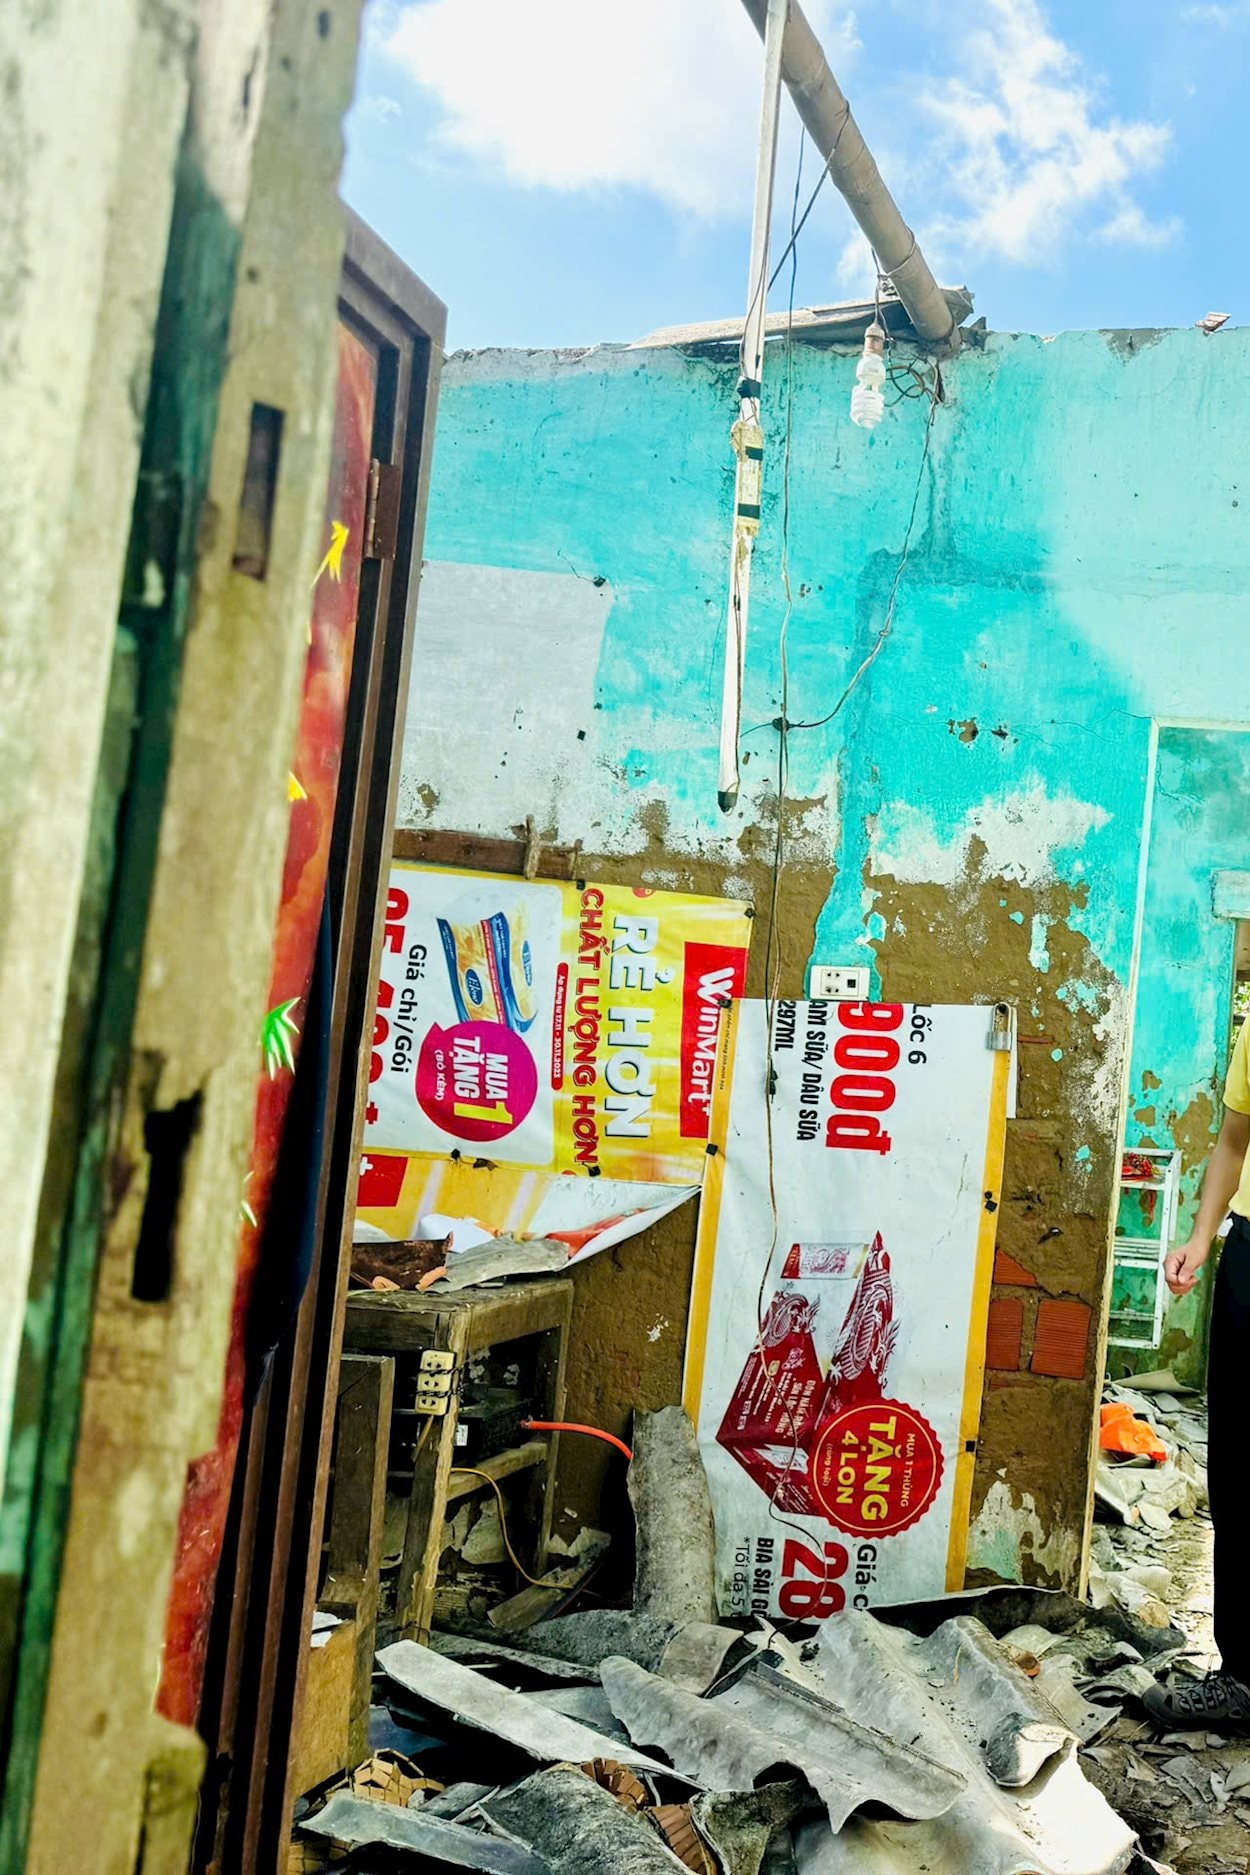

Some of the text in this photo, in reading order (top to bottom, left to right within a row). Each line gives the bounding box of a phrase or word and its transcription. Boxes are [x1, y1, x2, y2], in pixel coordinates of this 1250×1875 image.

[390, 943, 428, 1073] Giá chỉ/Gói
[568, 887, 611, 1165] CHẤT LƯỢNG HƠN
[604, 916, 672, 1139] RẺ HƠN
[801, 1030, 830, 1070] SỮA/
[908, 1050, 927, 1065] 6
[449, 1036, 513, 1125] TẶNG 1
[485, 1052, 509, 1100] MUA
[800, 1073, 825, 1105] DÂU
[797, 1109, 821, 1142] SỮA
[905, 1432, 916, 1458] MUA
[835, 1430, 859, 1505] 4 LON
[860, 1415, 903, 1521] TẶNG
[900, 1467, 916, 1508] THÙNG
[755, 1537, 775, 1564] BIA
[855, 1544, 878, 1585] Giá
[733, 1572, 750, 1593] đa
[752, 1567, 774, 1595] SÀI
[778, 1538, 850, 1619] 28
[731, 1596, 746, 1607] 5
